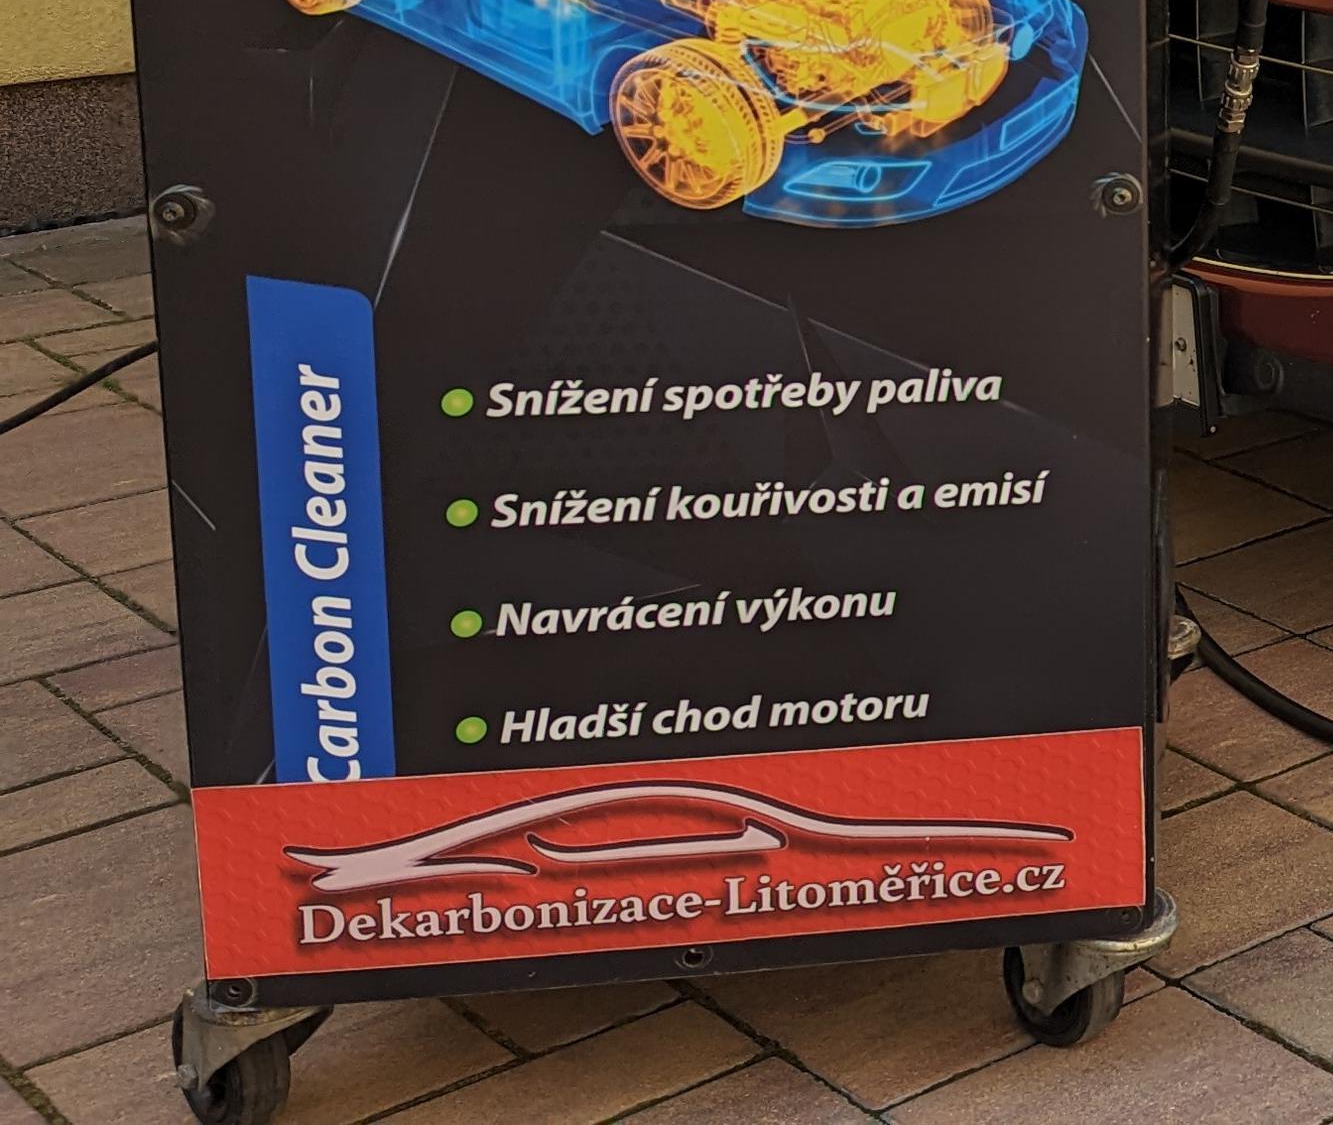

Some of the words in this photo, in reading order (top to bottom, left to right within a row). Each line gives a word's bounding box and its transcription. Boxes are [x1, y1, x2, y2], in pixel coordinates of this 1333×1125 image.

[486, 377, 659, 418] Snížení
[662, 372, 861, 420] spotřeby
[866, 368, 1003, 413] paliva
[291, 363, 350, 580] Cleaner
[490, 487, 662, 528] Snížení
[665, 477, 890, 521] kouřivosti
[897, 484, 926, 511] a
[933, 469, 1051, 509] emisí
[496, 590, 731, 637] Navrácení
[736, 587, 897, 633] výkonu
[299, 595, 360, 783] Carbon
[501, 702, 648, 744] Hladší
[652, 695, 762, 735] chod
[768, 693, 930, 727] motoru
[297, 861, 1066, 945] Dekarbonizace-Litoměřice.cz
